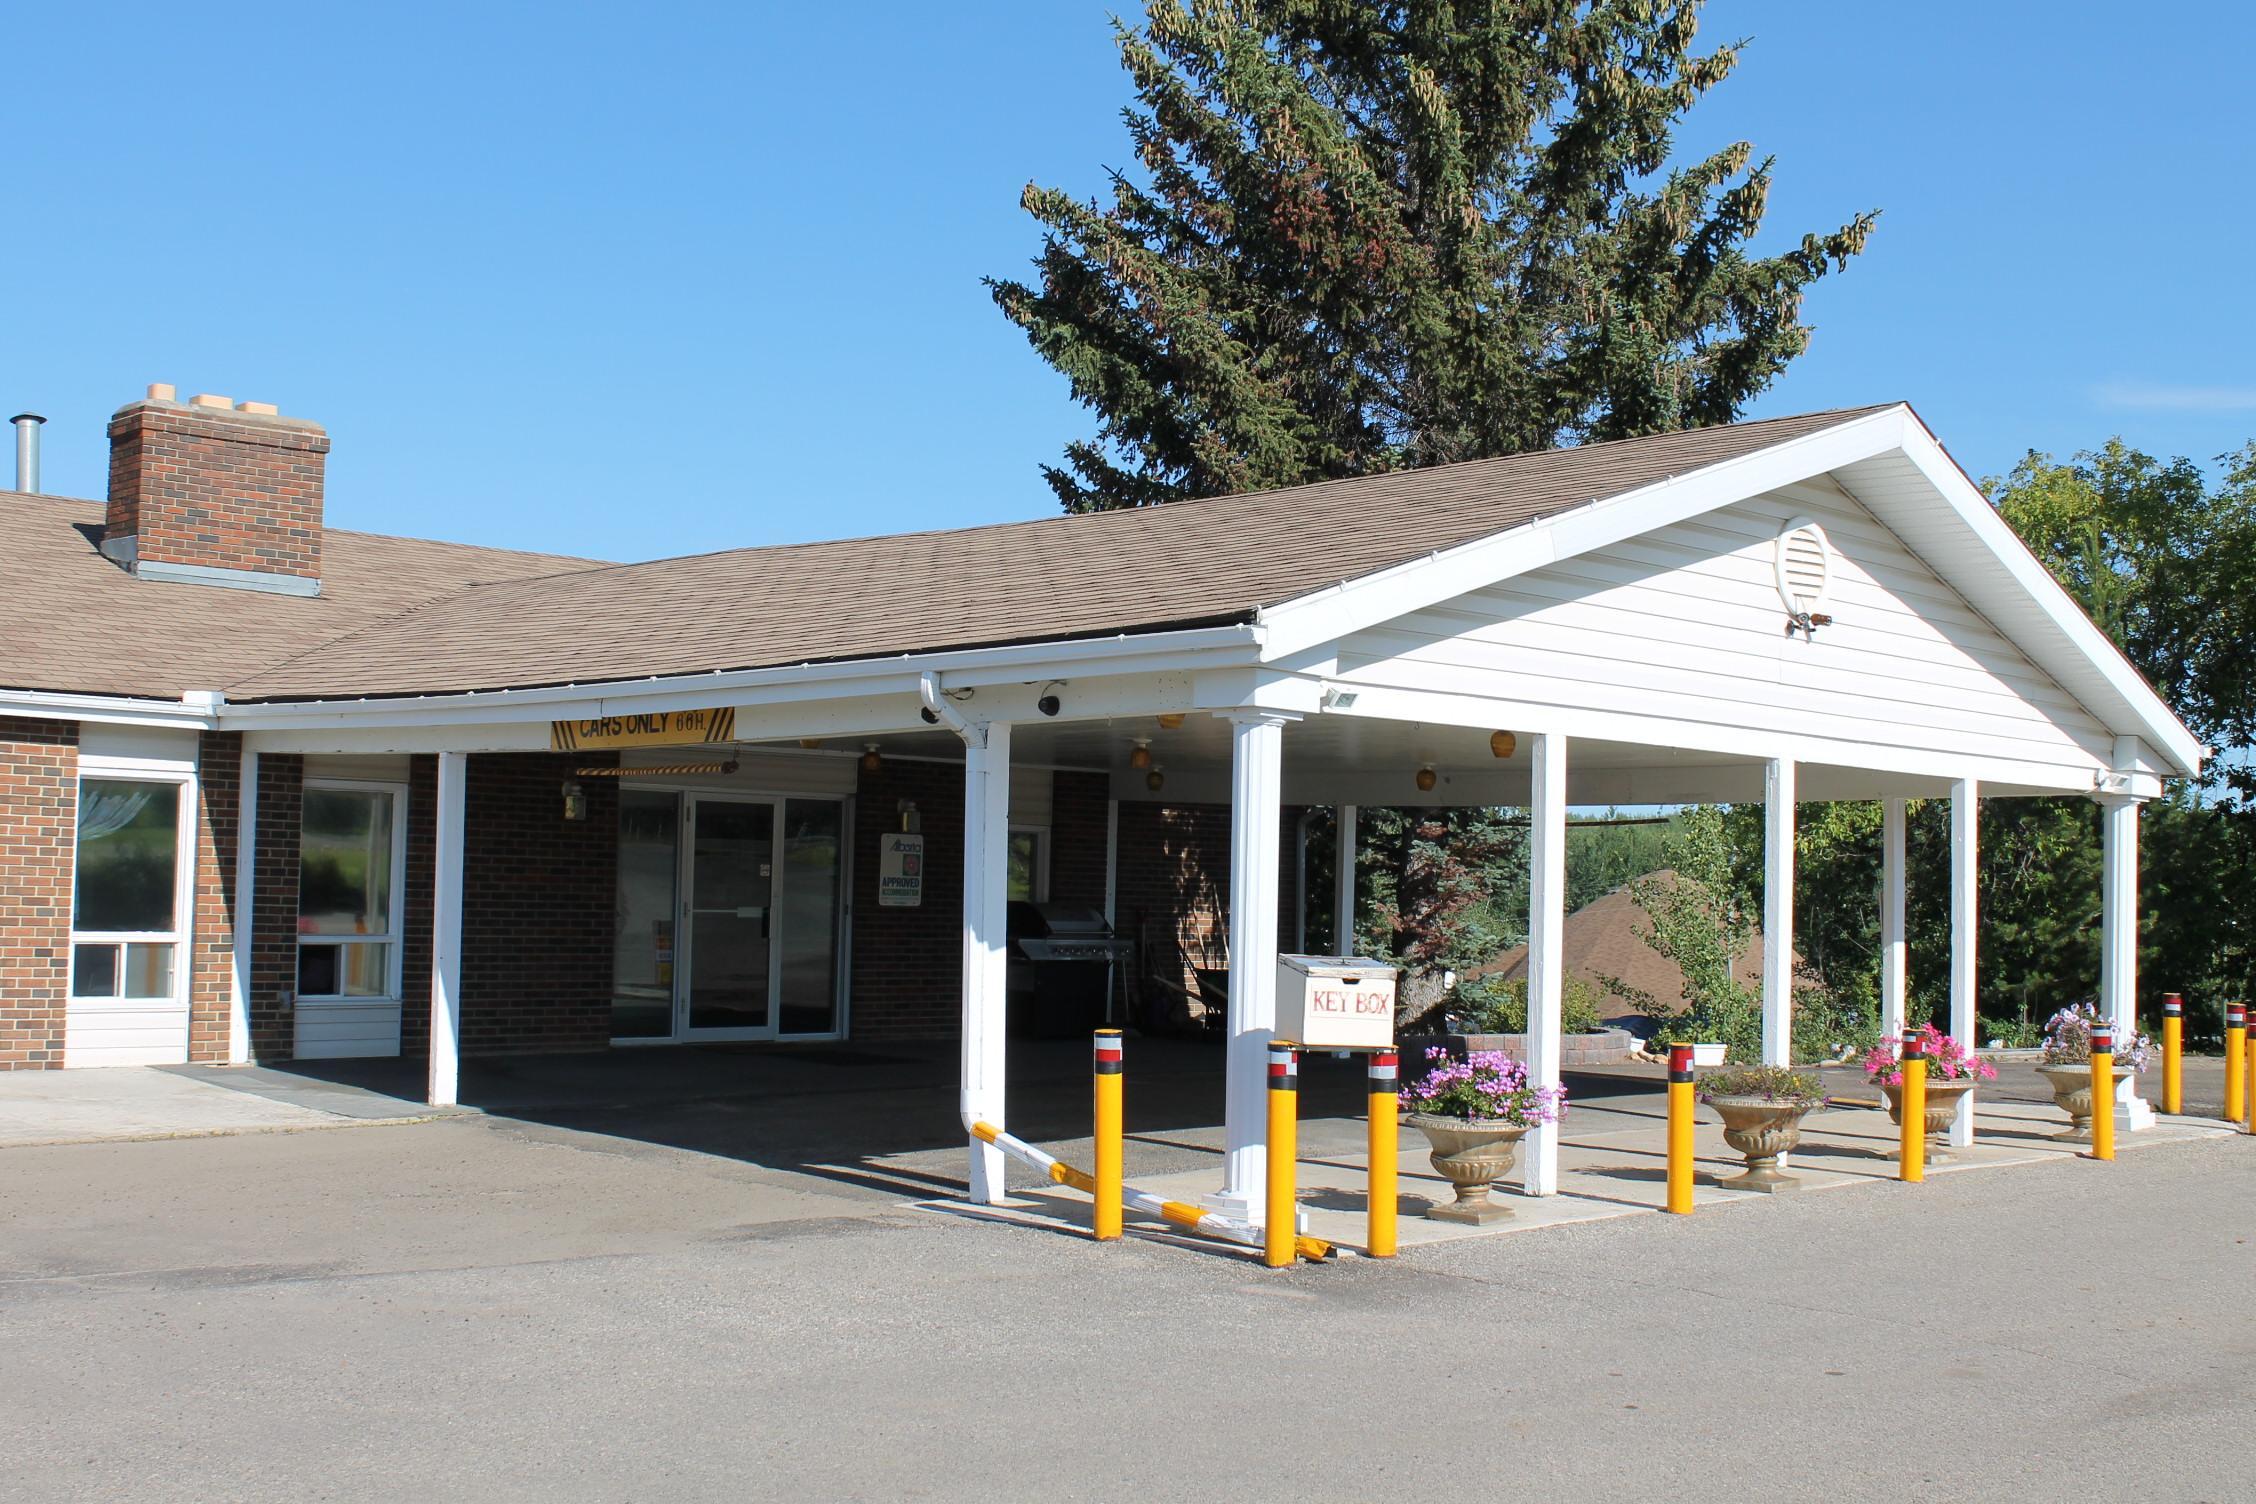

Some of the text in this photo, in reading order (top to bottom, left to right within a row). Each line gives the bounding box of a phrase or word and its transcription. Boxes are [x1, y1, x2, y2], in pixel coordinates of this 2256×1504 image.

[580, 716, 622, 737] CARS
[627, 712, 670, 734] ONLY
[882, 876, 920, 888] APPROVED
[1313, 990, 1390, 1015] KEY BOX
